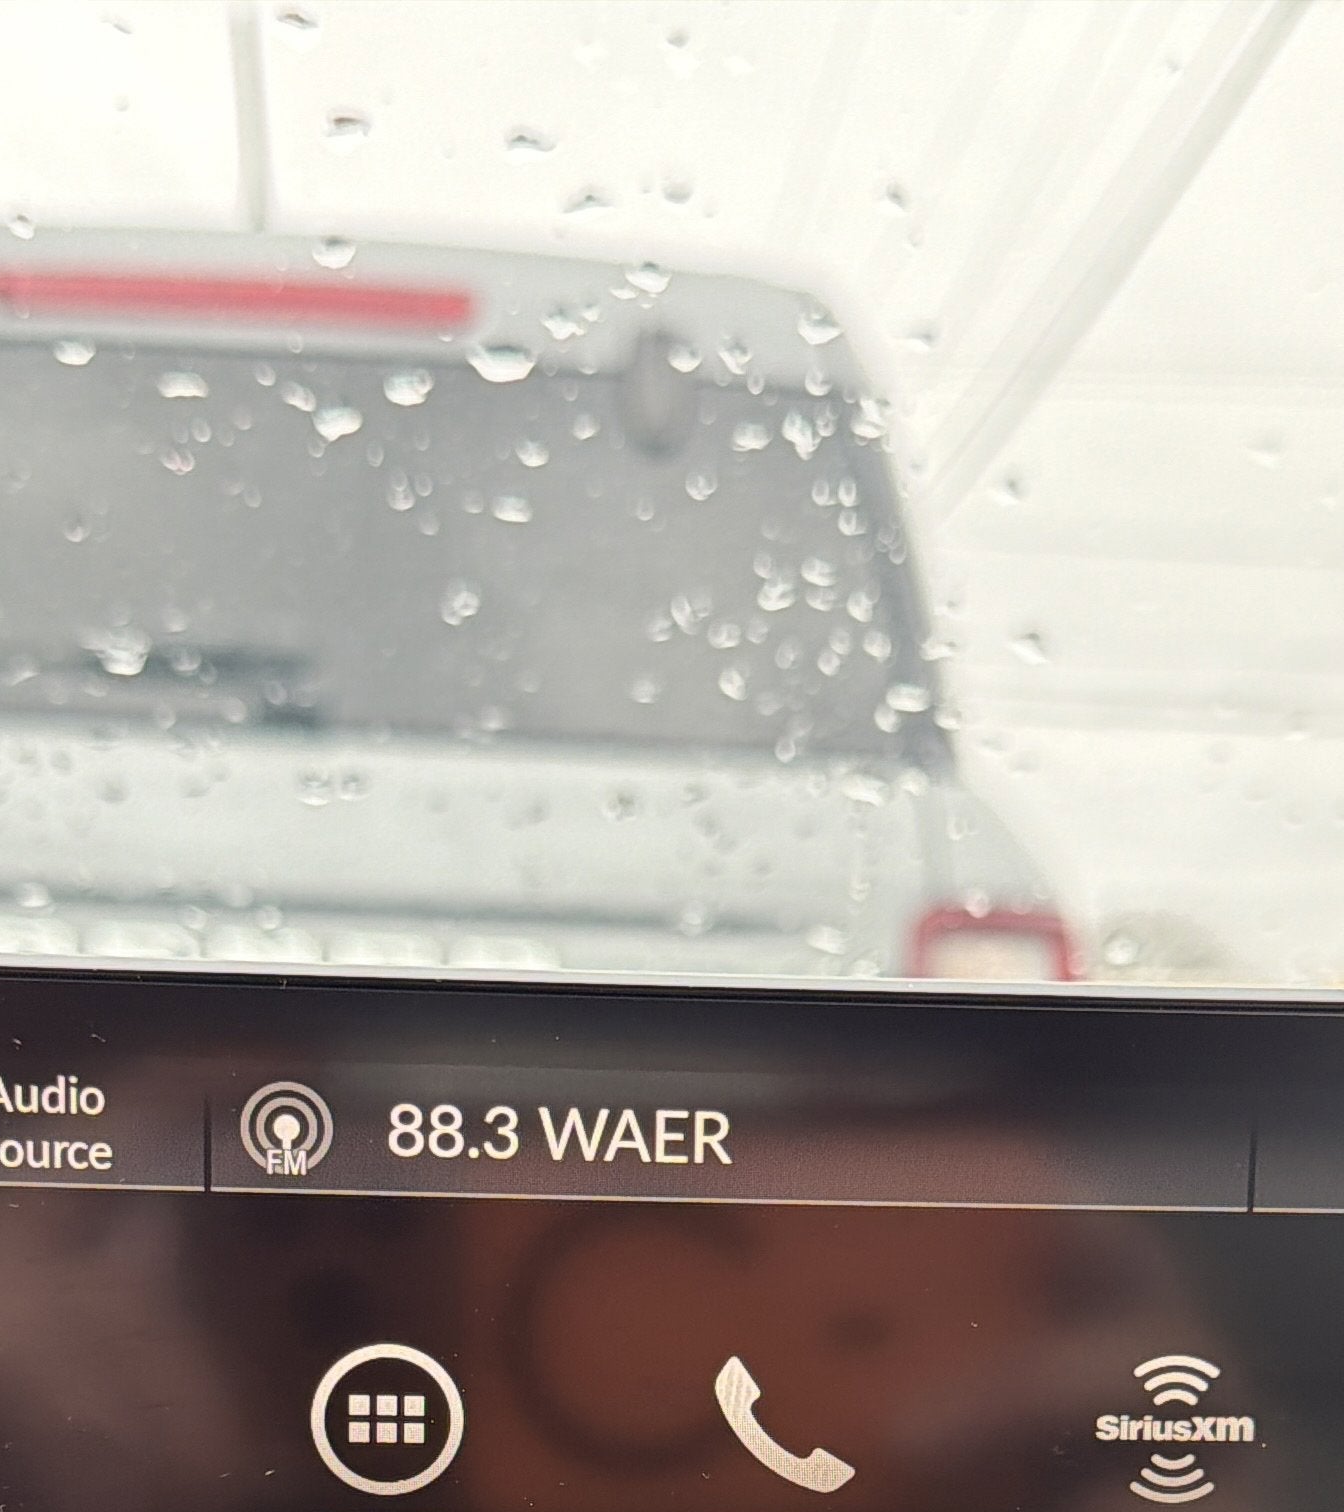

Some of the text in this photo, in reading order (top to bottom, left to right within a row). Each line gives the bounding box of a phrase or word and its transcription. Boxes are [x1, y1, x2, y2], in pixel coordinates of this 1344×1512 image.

[388, 1103, 733, 1165] 88.3 WAER
[266, 1149, 307, 1176] FM
